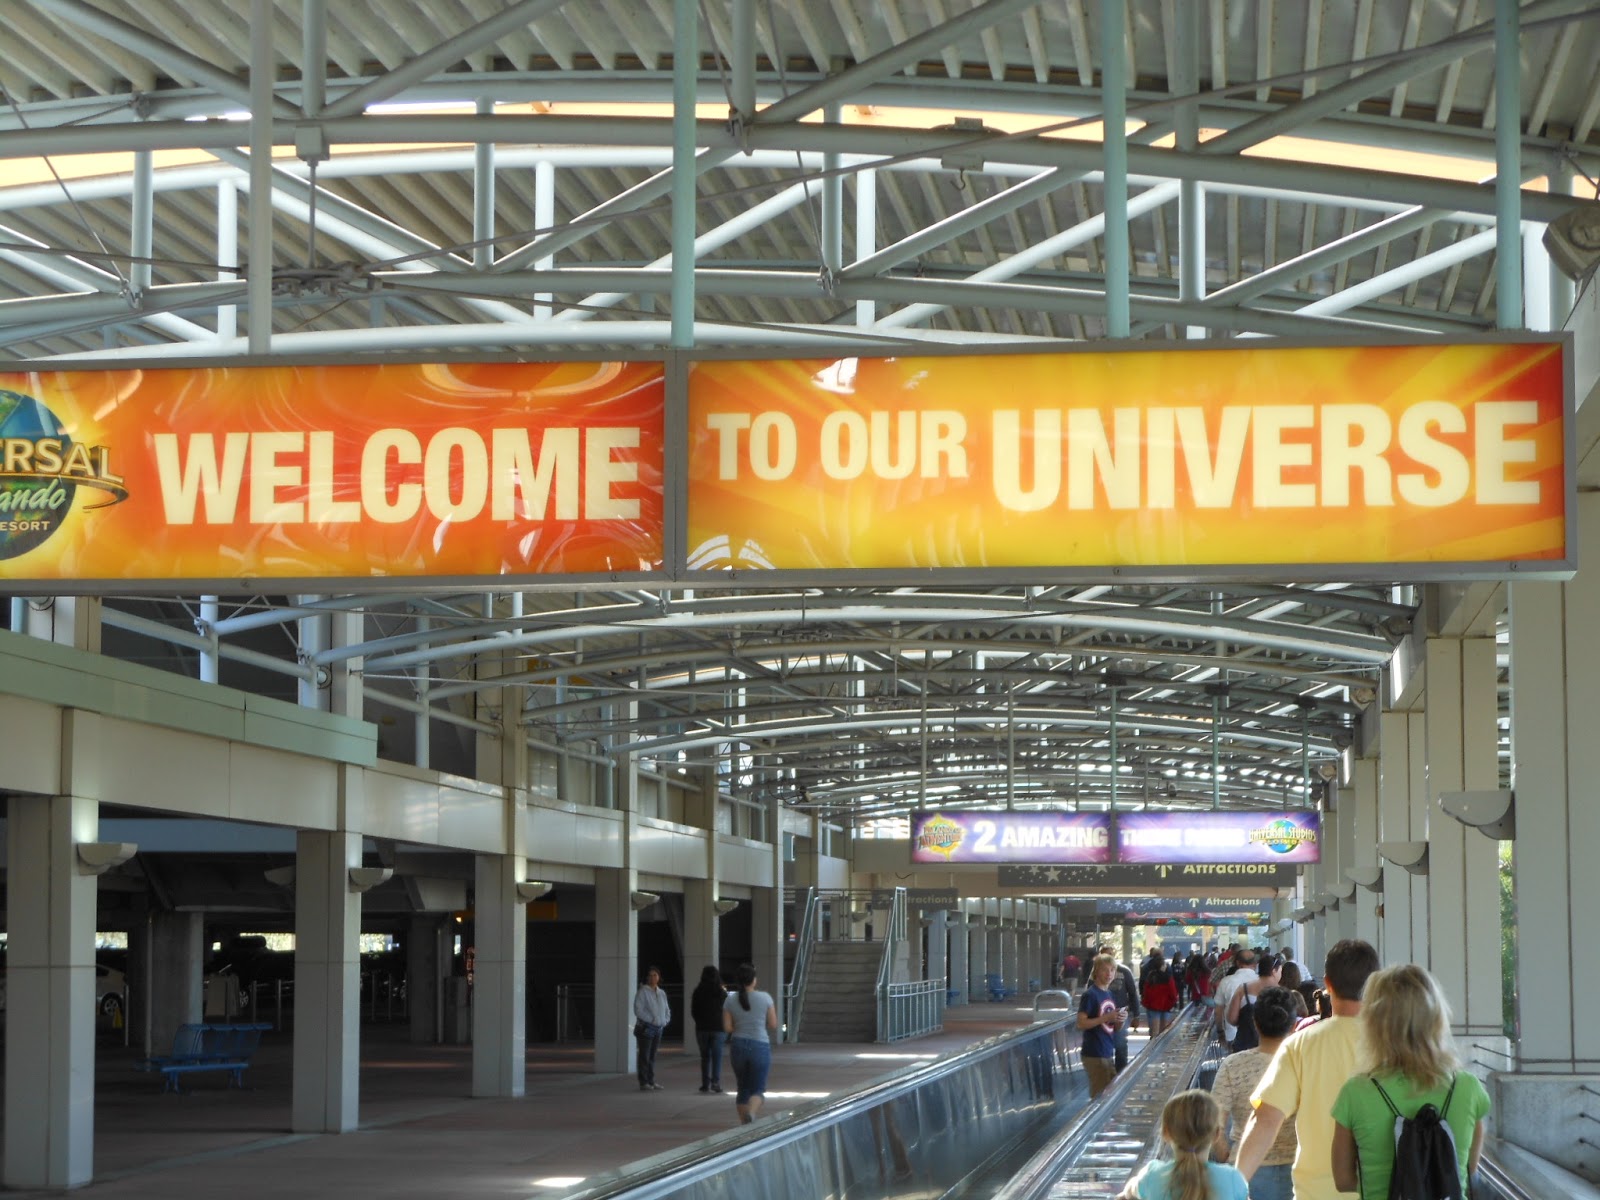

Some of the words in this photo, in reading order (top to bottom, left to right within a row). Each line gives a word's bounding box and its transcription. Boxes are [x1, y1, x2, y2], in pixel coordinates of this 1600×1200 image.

[0, 438, 124, 484] RSAL
[707, 411, 797, 483] TO
[819, 409, 968, 481] OUR
[992, 400, 1540, 511] UNIVERSE
[154, 426, 641, 525] WELCOME
[973, 820, 997, 853] 2
[1001, 826, 1109, 848] AMAZING
[1183, 865, 1277, 874] Attractions
[1205, 897, 1261, 906] Attractions
